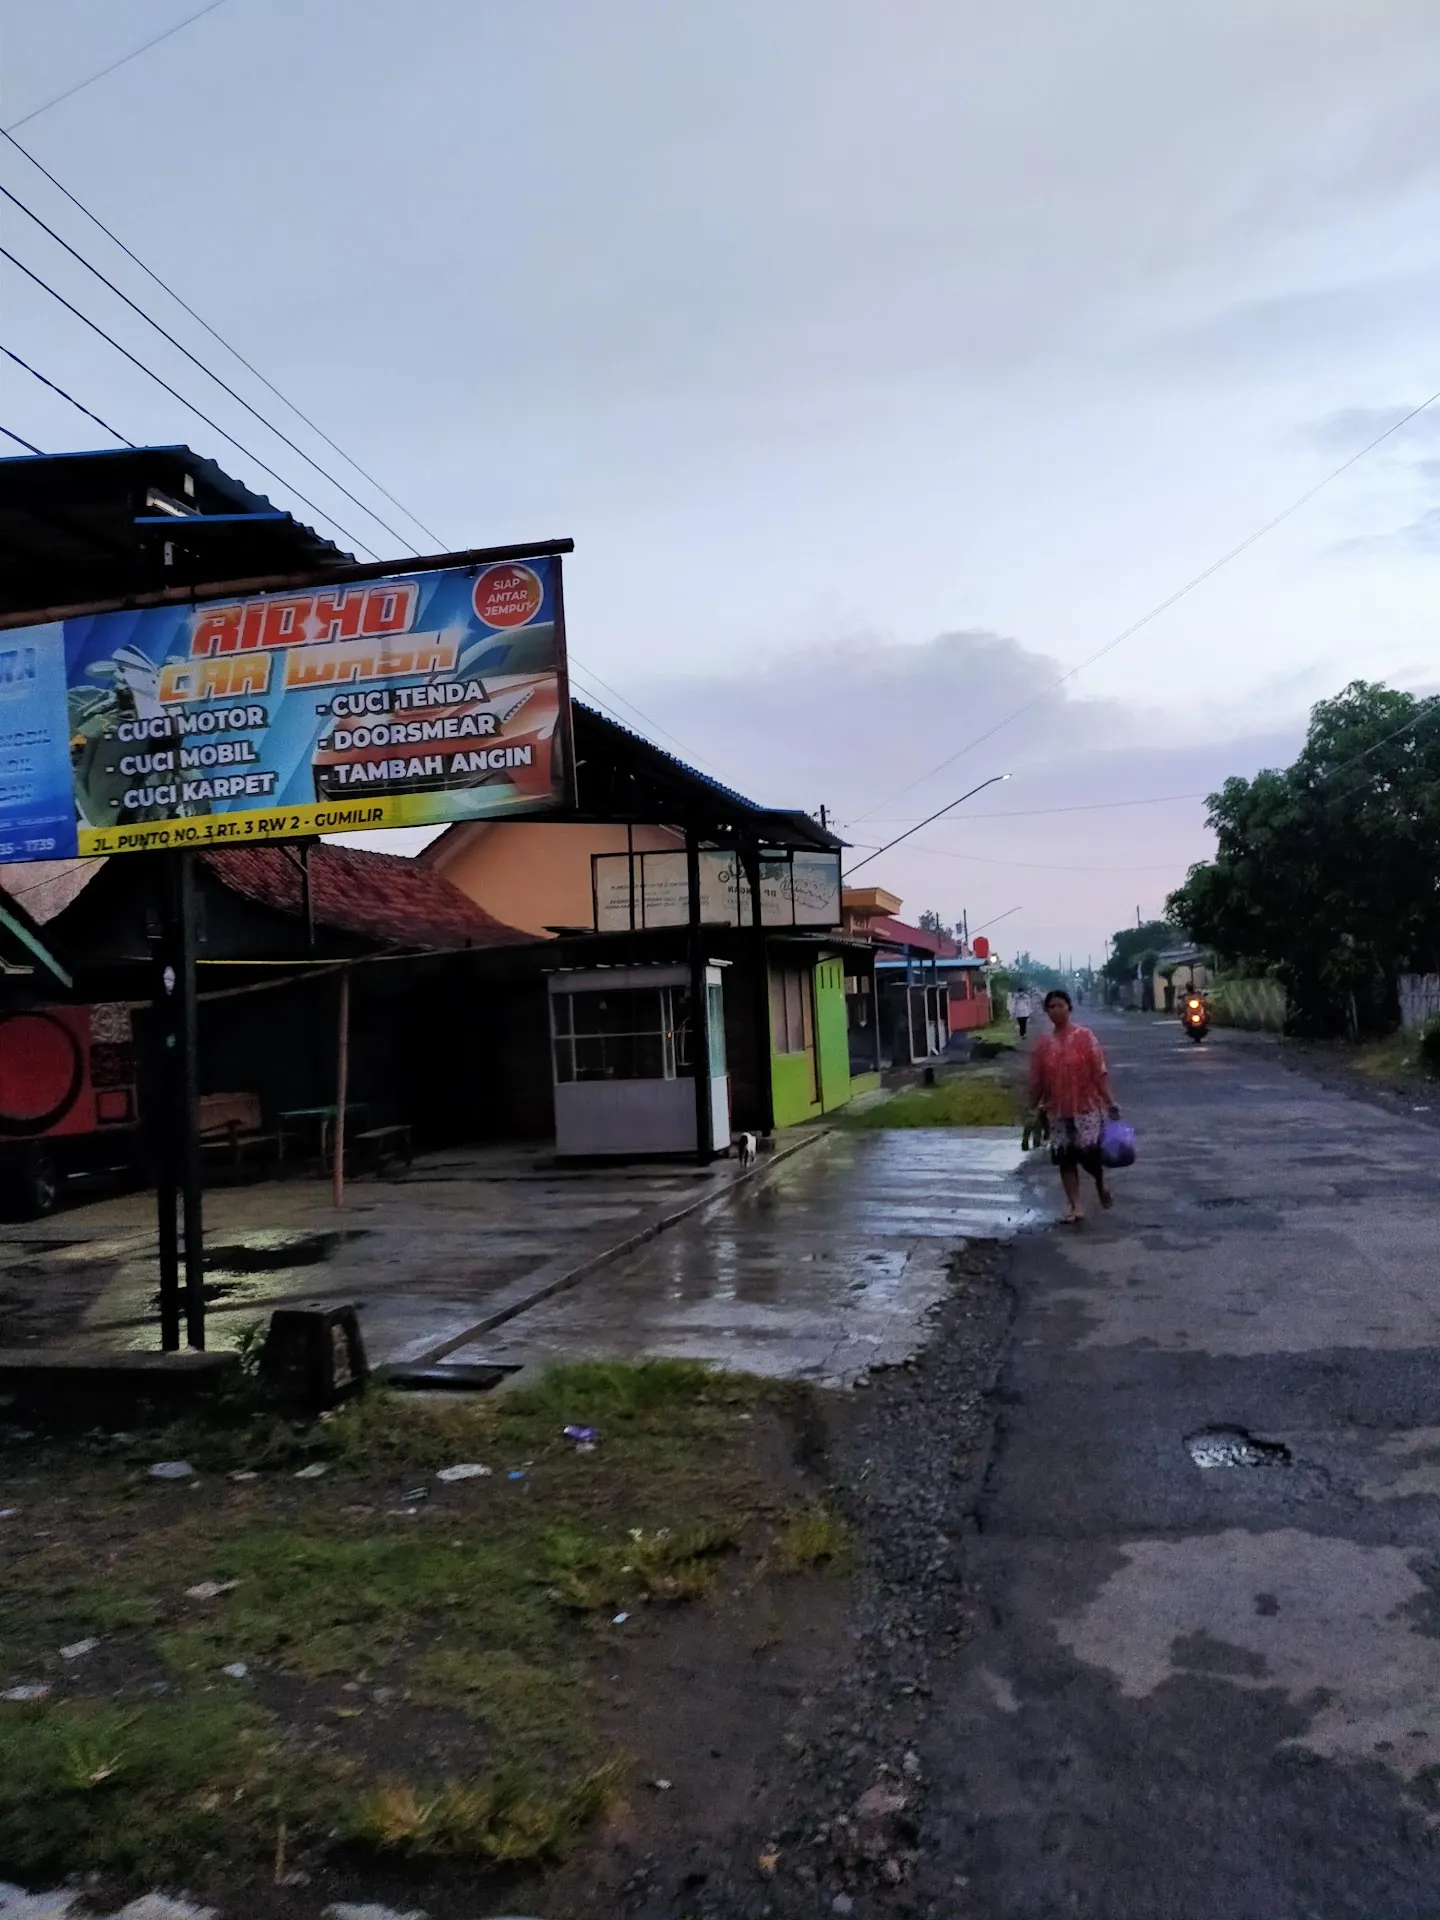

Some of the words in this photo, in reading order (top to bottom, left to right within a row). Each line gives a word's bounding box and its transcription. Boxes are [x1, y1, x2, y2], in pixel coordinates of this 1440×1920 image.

[487, 589, 528, 604] ANTAR
[493, 578, 520, 590] SIAP
[484, 601, 532, 616] JEMPUT
[158, 652, 271, 702] CAR
[284, 630, 461, 689] WASH
[331, 691, 390, 716] CUCI
[395, 681, 484, 709] TENDA
[117, 718, 172, 742] CUCI
[178, 706, 264, 735] MOTOR
[334, 715, 495, 751] DOORSMEAR
[119, 751, 175, 776] CUCI
[180, 741, 256, 769] MOBIL
[334, 754, 444, 784] TAMBAH
[450, 745, 532, 773] ANGIN
[123, 785, 177, 809] CUCI
[182, 773, 275, 802] KARPET
[117, 829, 170, 849] PUNTO
[174, 826, 201, 841] NO.
[245, 821, 254, 834] 3
[258, 817, 287, 833] RW
[290, 815, 300, 830] 2
[314, 808, 384, 828] GUMILIR
